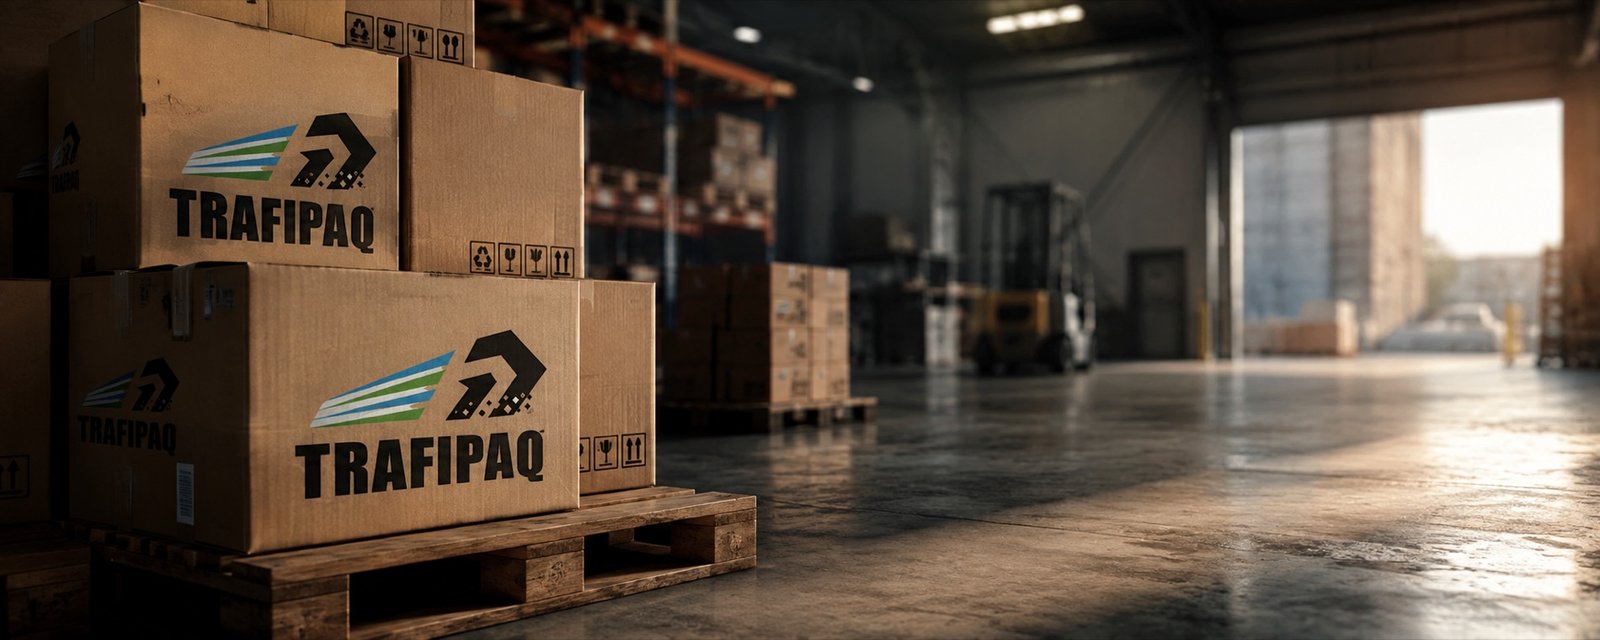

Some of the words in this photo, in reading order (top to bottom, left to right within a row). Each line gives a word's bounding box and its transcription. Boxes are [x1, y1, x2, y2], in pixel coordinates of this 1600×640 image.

[169, 188, 374, 254] TRAFIPAQ
[78, 415, 177, 456] TRAFIPAQ
[295, 429, 544, 499] TRAFIPAQ
